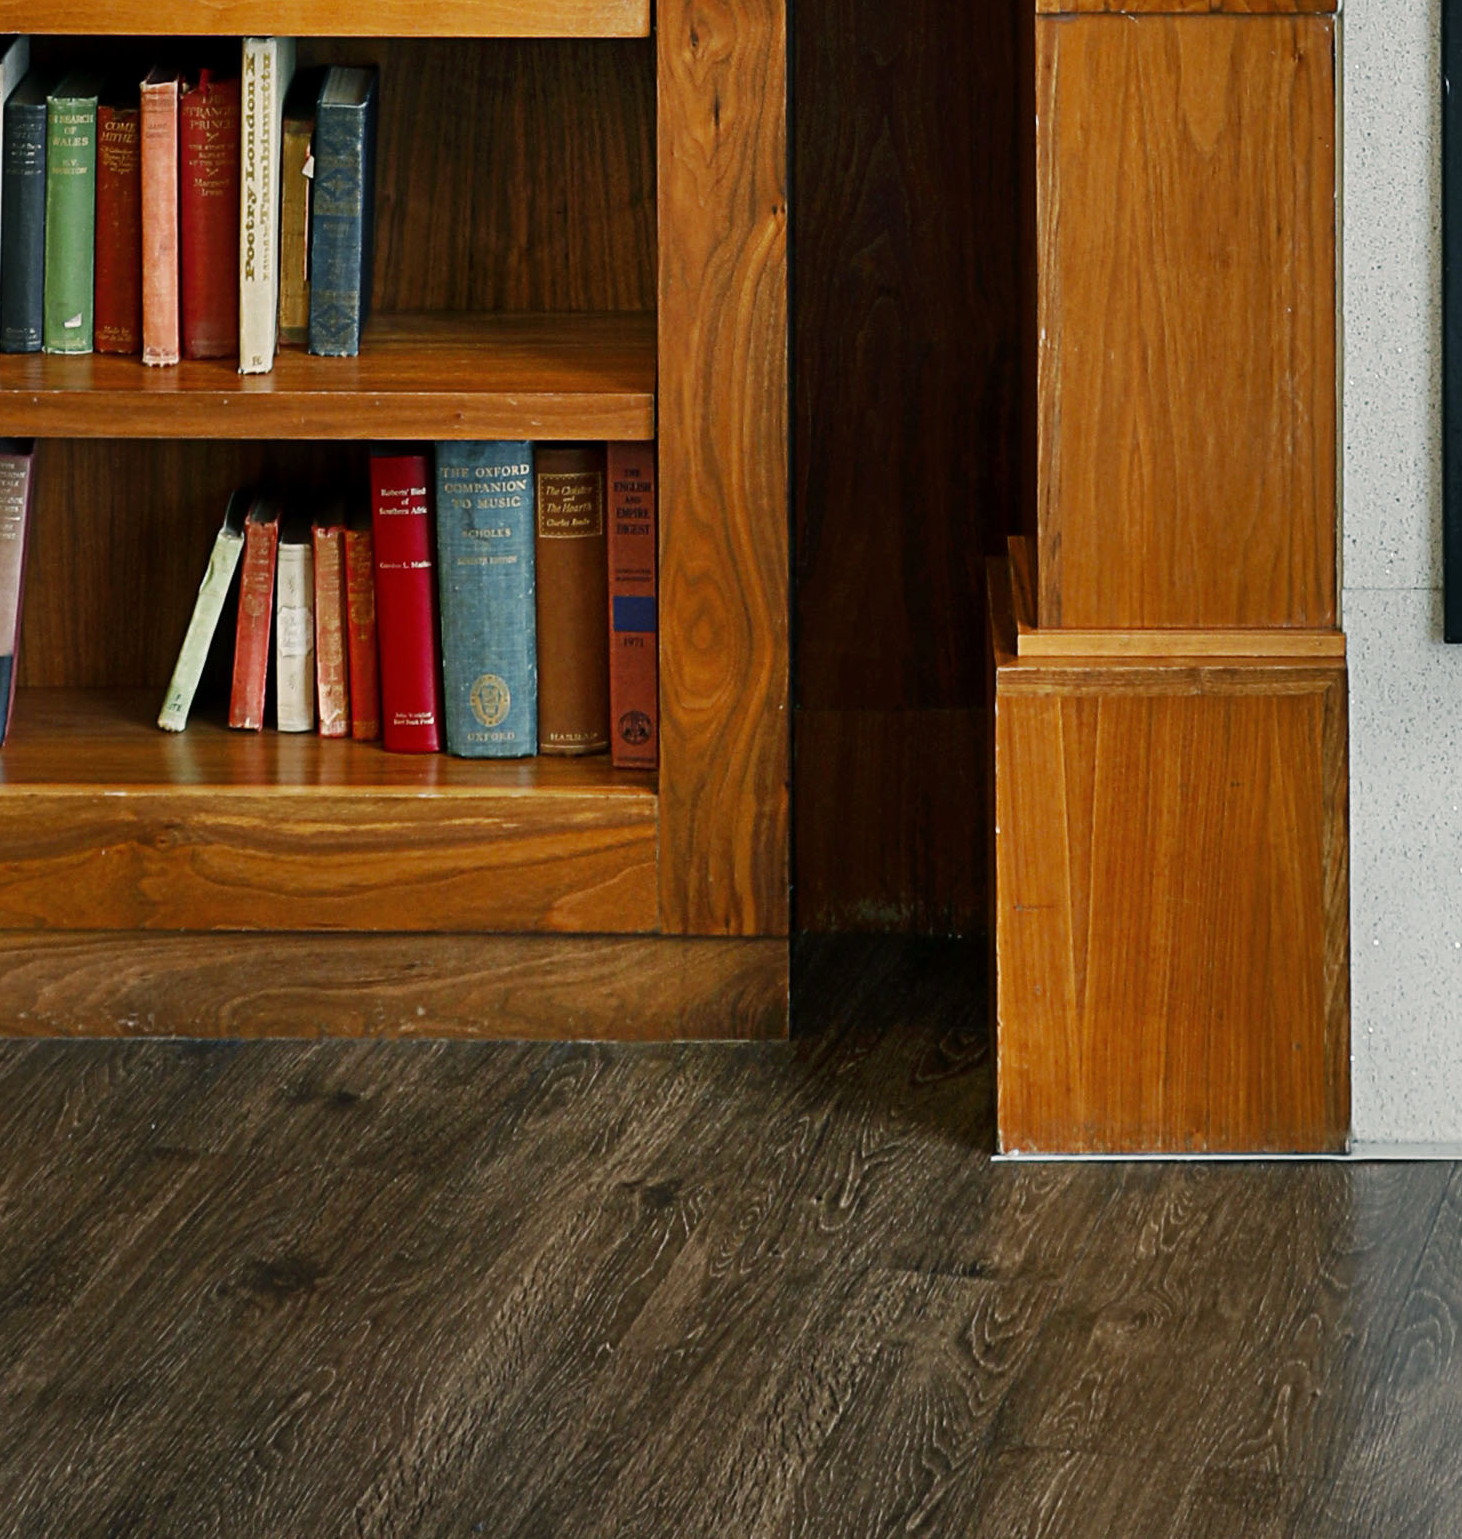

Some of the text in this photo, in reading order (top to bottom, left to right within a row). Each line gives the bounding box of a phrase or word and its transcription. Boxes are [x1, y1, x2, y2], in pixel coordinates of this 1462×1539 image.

[245, 81, 255, 181] London
[245, 187, 256, 281] Poetry
[475, 464, 529, 477] OXFORD
[444, 480, 527, 493] COMPANION
[478, 497, 521, 508] MUSIC
